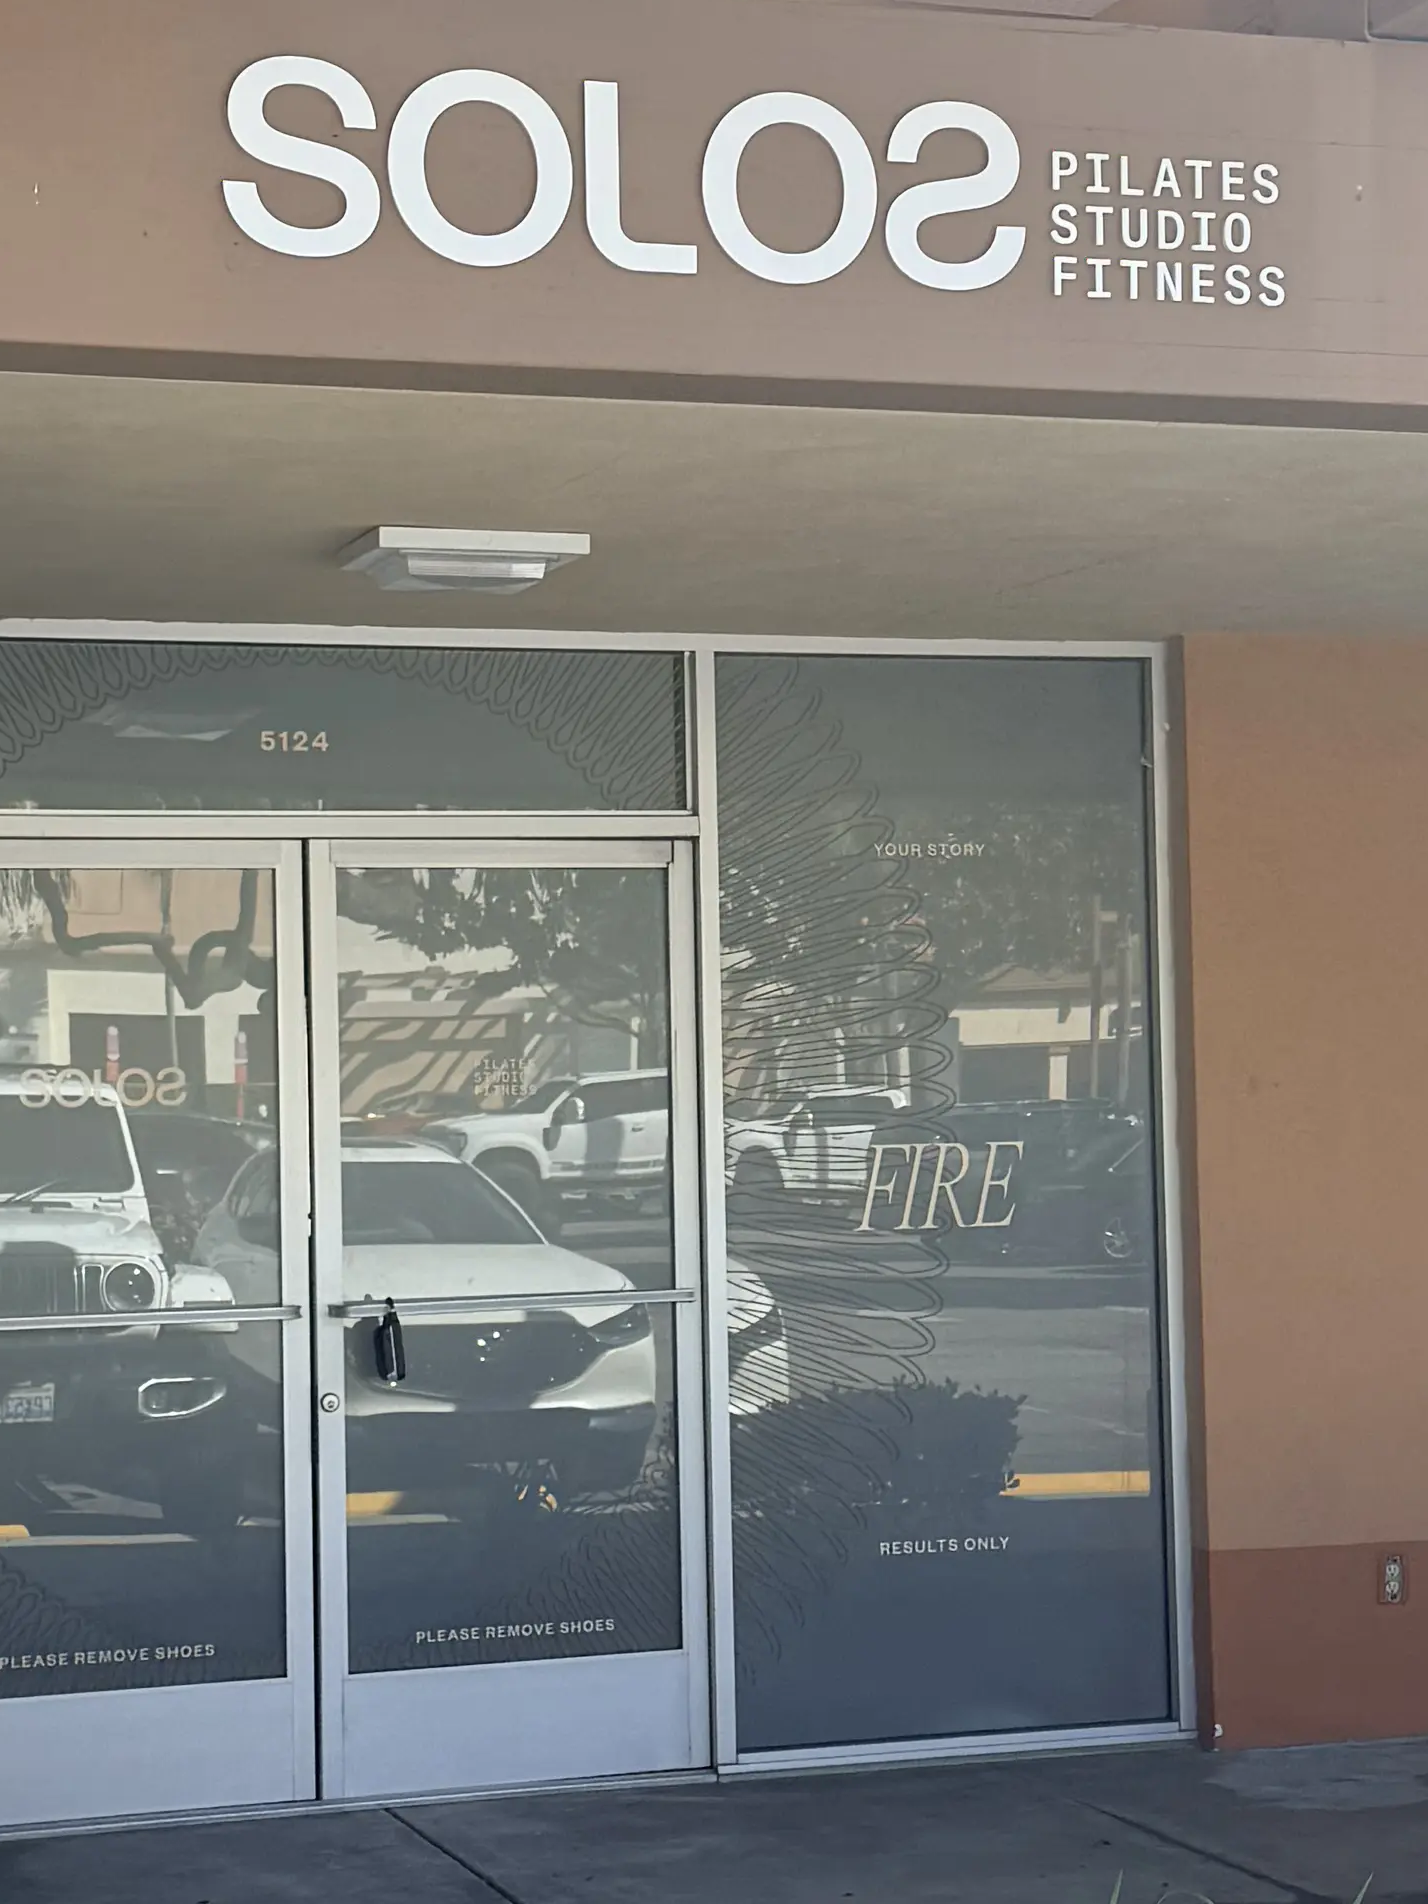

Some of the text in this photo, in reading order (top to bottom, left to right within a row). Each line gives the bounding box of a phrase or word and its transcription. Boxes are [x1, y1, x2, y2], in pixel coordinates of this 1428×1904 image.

[222, 55, 1026, 291] SOLOS
[1052, 151, 1279, 204] PILATES
[1050, 203, 1252, 254] STUDIO
[1053, 256, 1285, 307] FITNESS
[260, 730, 329, 752] 5124
[874, 843, 985, 857] YOUR STORY
[854, 1141, 1024, 1231] FIRE
[879, 1536, 1009, 1555] RESULTS ONLY
[416, 1619, 615, 1643] PLEASE REMOVE SHOES
[74, 1647, 150, 1665] REMOVE
[155, 1644, 216, 1659] SHOES
